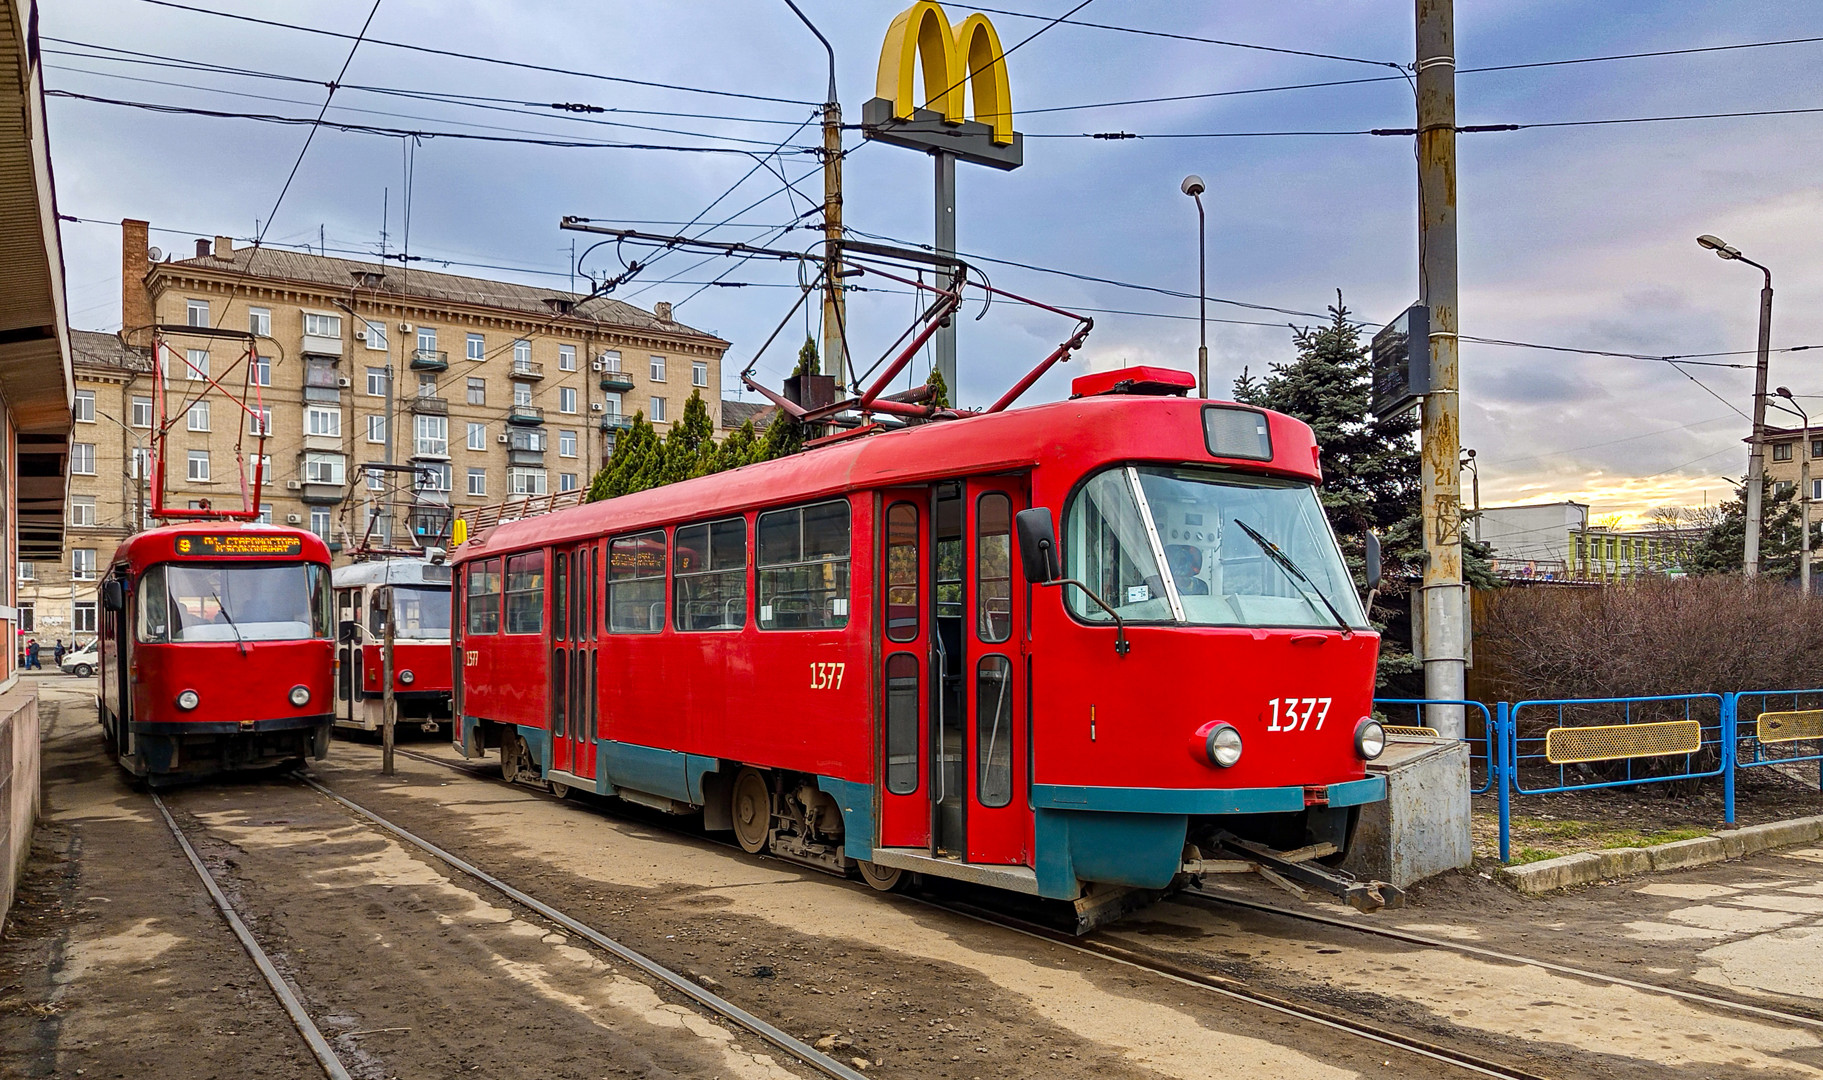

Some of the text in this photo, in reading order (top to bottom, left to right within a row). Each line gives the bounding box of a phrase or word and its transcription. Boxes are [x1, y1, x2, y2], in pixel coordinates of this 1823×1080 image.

[180, 539, 190, 552] 9
[466, 651, 478, 666] 1377
[810, 662, 845, 690] 1377
[1267, 697, 1332, 732] 1377
